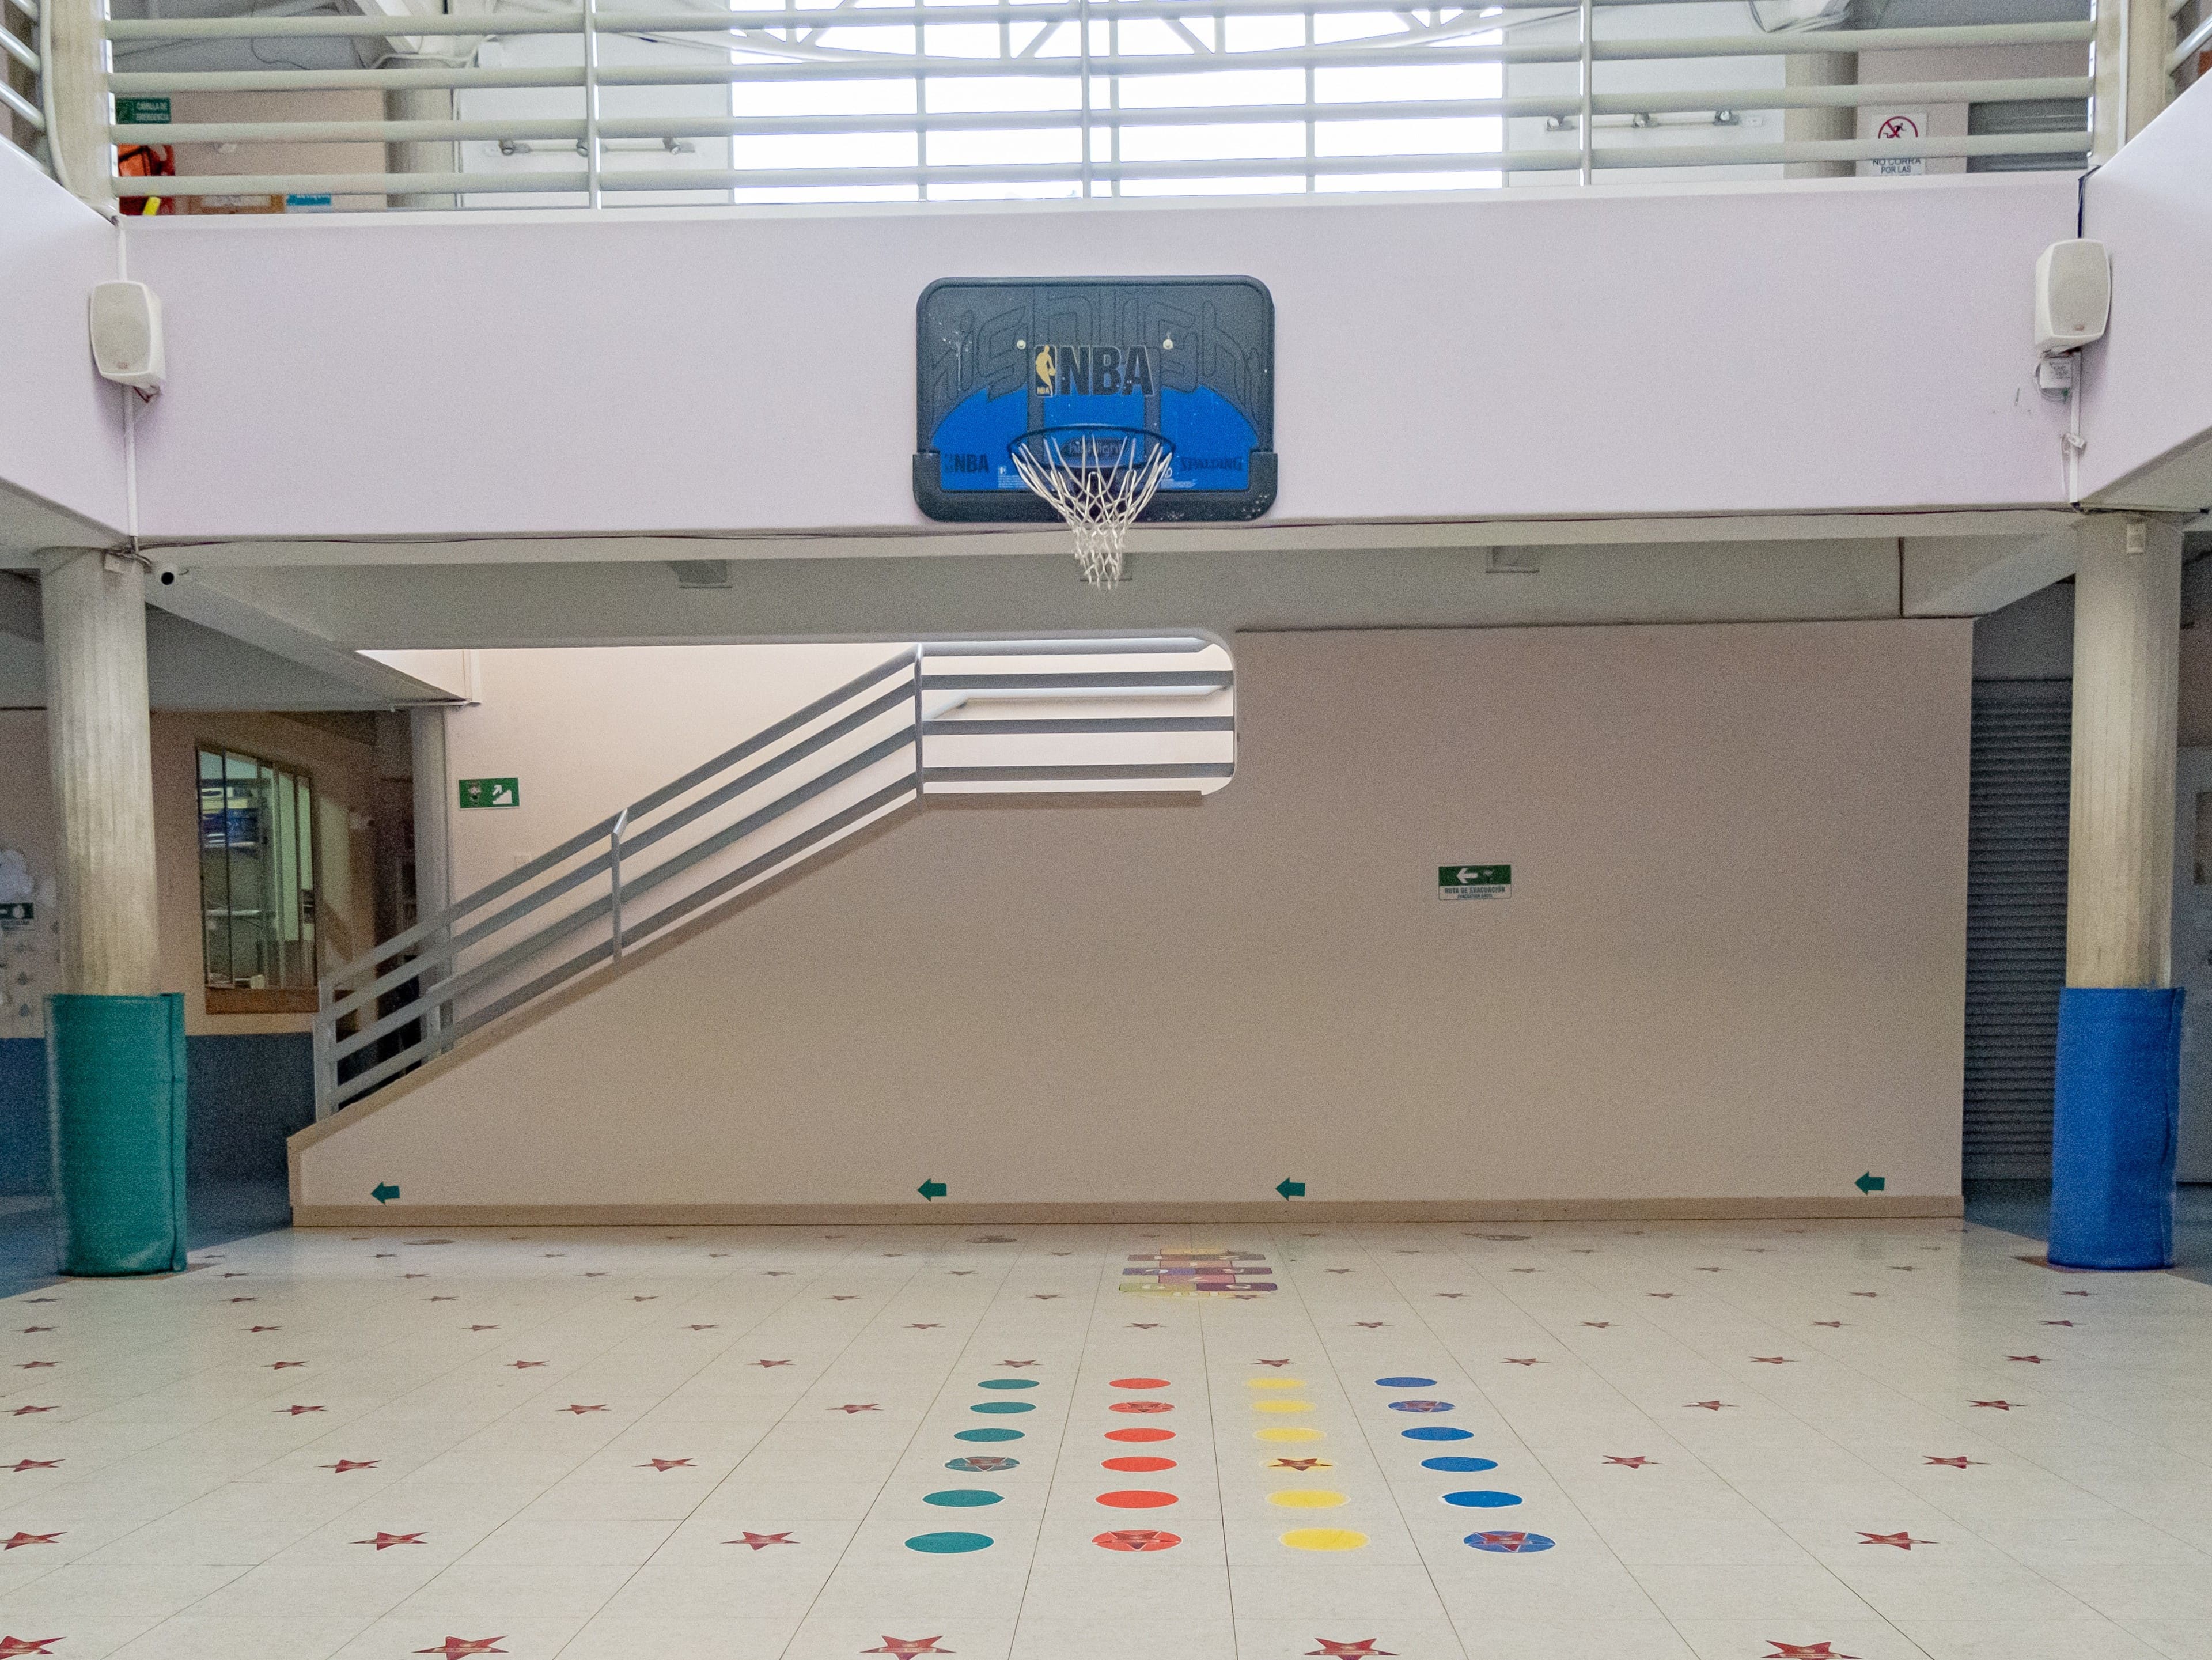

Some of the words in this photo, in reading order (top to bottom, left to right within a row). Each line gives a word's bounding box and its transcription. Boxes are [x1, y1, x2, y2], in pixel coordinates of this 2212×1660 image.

[1889, 157, 1921, 165] CORRA
[1881, 166, 1896, 174] POR
[1060, 346, 1154, 396] NBA
[954, 453, 990, 474] NBA
[1181, 456, 1243, 471] SPALDING
